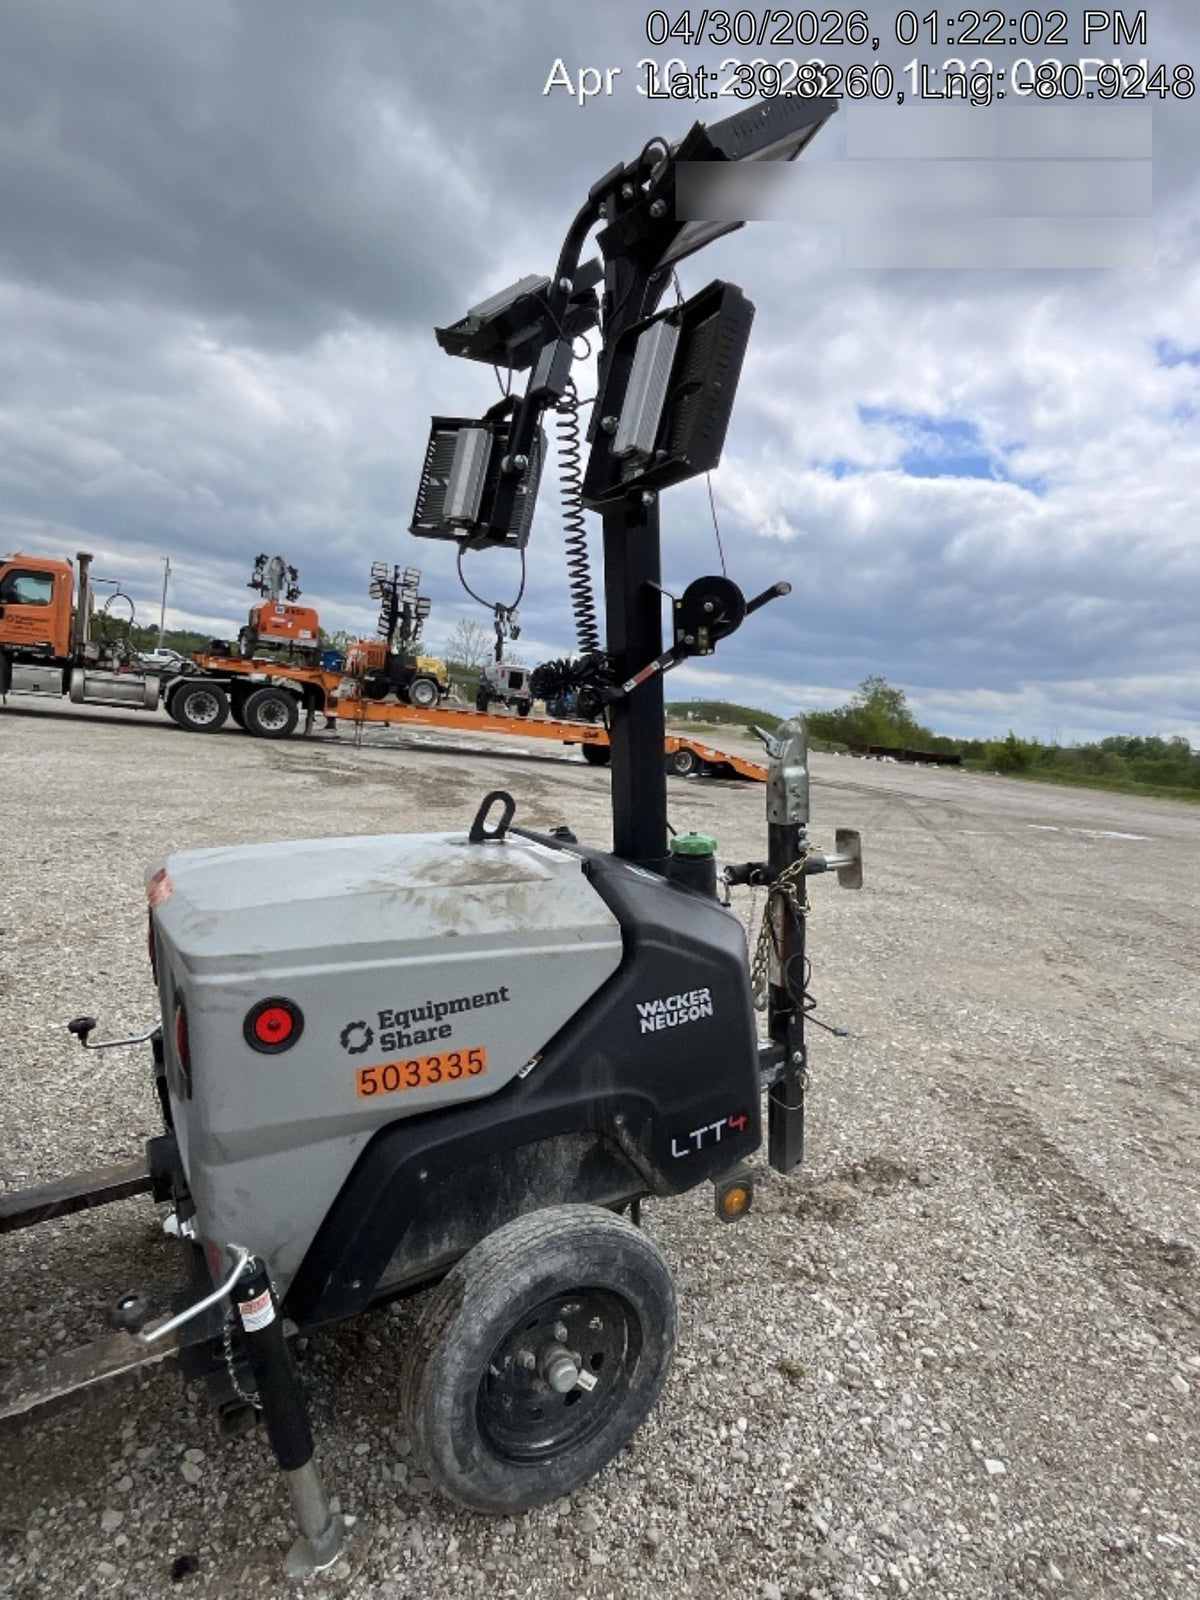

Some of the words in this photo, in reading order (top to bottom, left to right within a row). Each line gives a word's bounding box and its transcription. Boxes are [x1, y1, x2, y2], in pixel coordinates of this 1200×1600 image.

[378, 985, 511, 1031] Equipment
[636, 987, 712, 1018] WACKER
[639, 1002, 714, 1034] NEUSON
[380, 1023, 452, 1053] Share
[360, 1049, 484, 1096] 503335
[671, 1115, 748, 1158] LTT4
